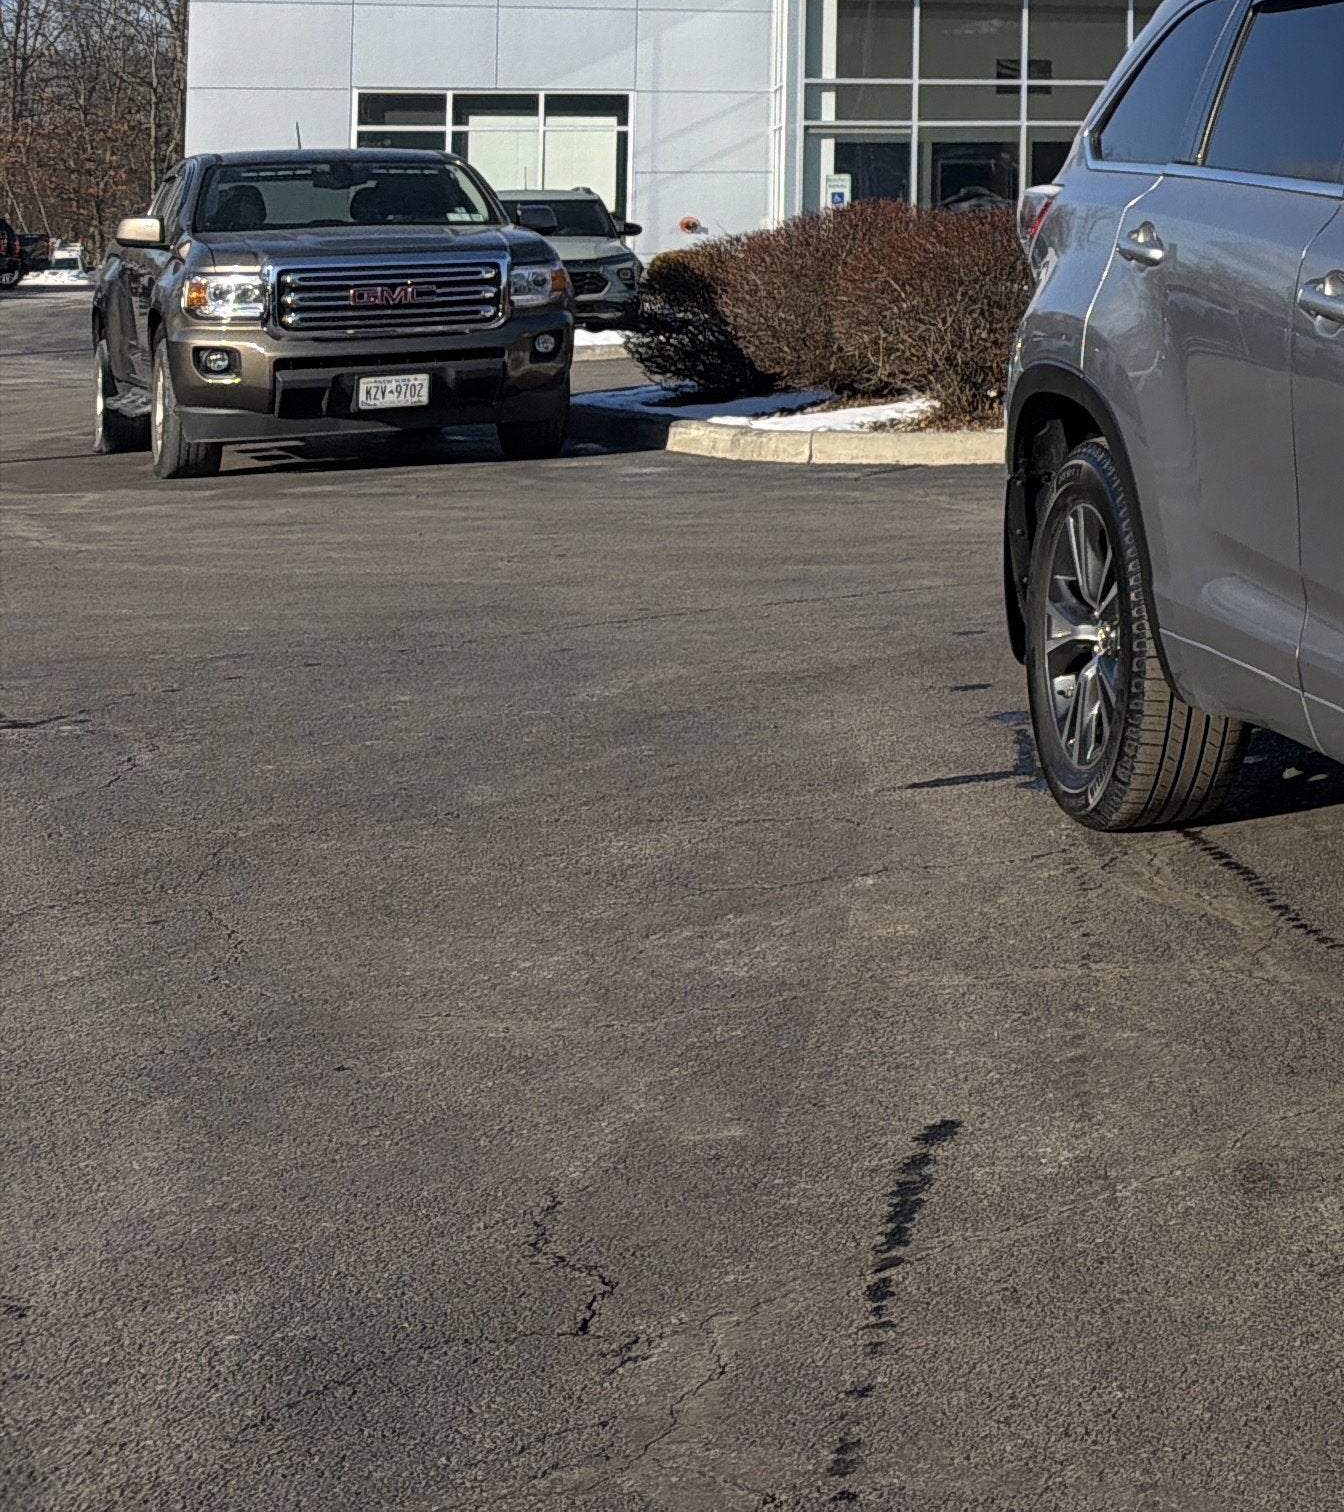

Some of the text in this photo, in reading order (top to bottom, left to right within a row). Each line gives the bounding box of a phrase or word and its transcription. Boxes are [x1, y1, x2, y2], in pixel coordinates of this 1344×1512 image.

[350, 285, 436, 306] GMC
[365, 382, 424, 402] KZV 9702
